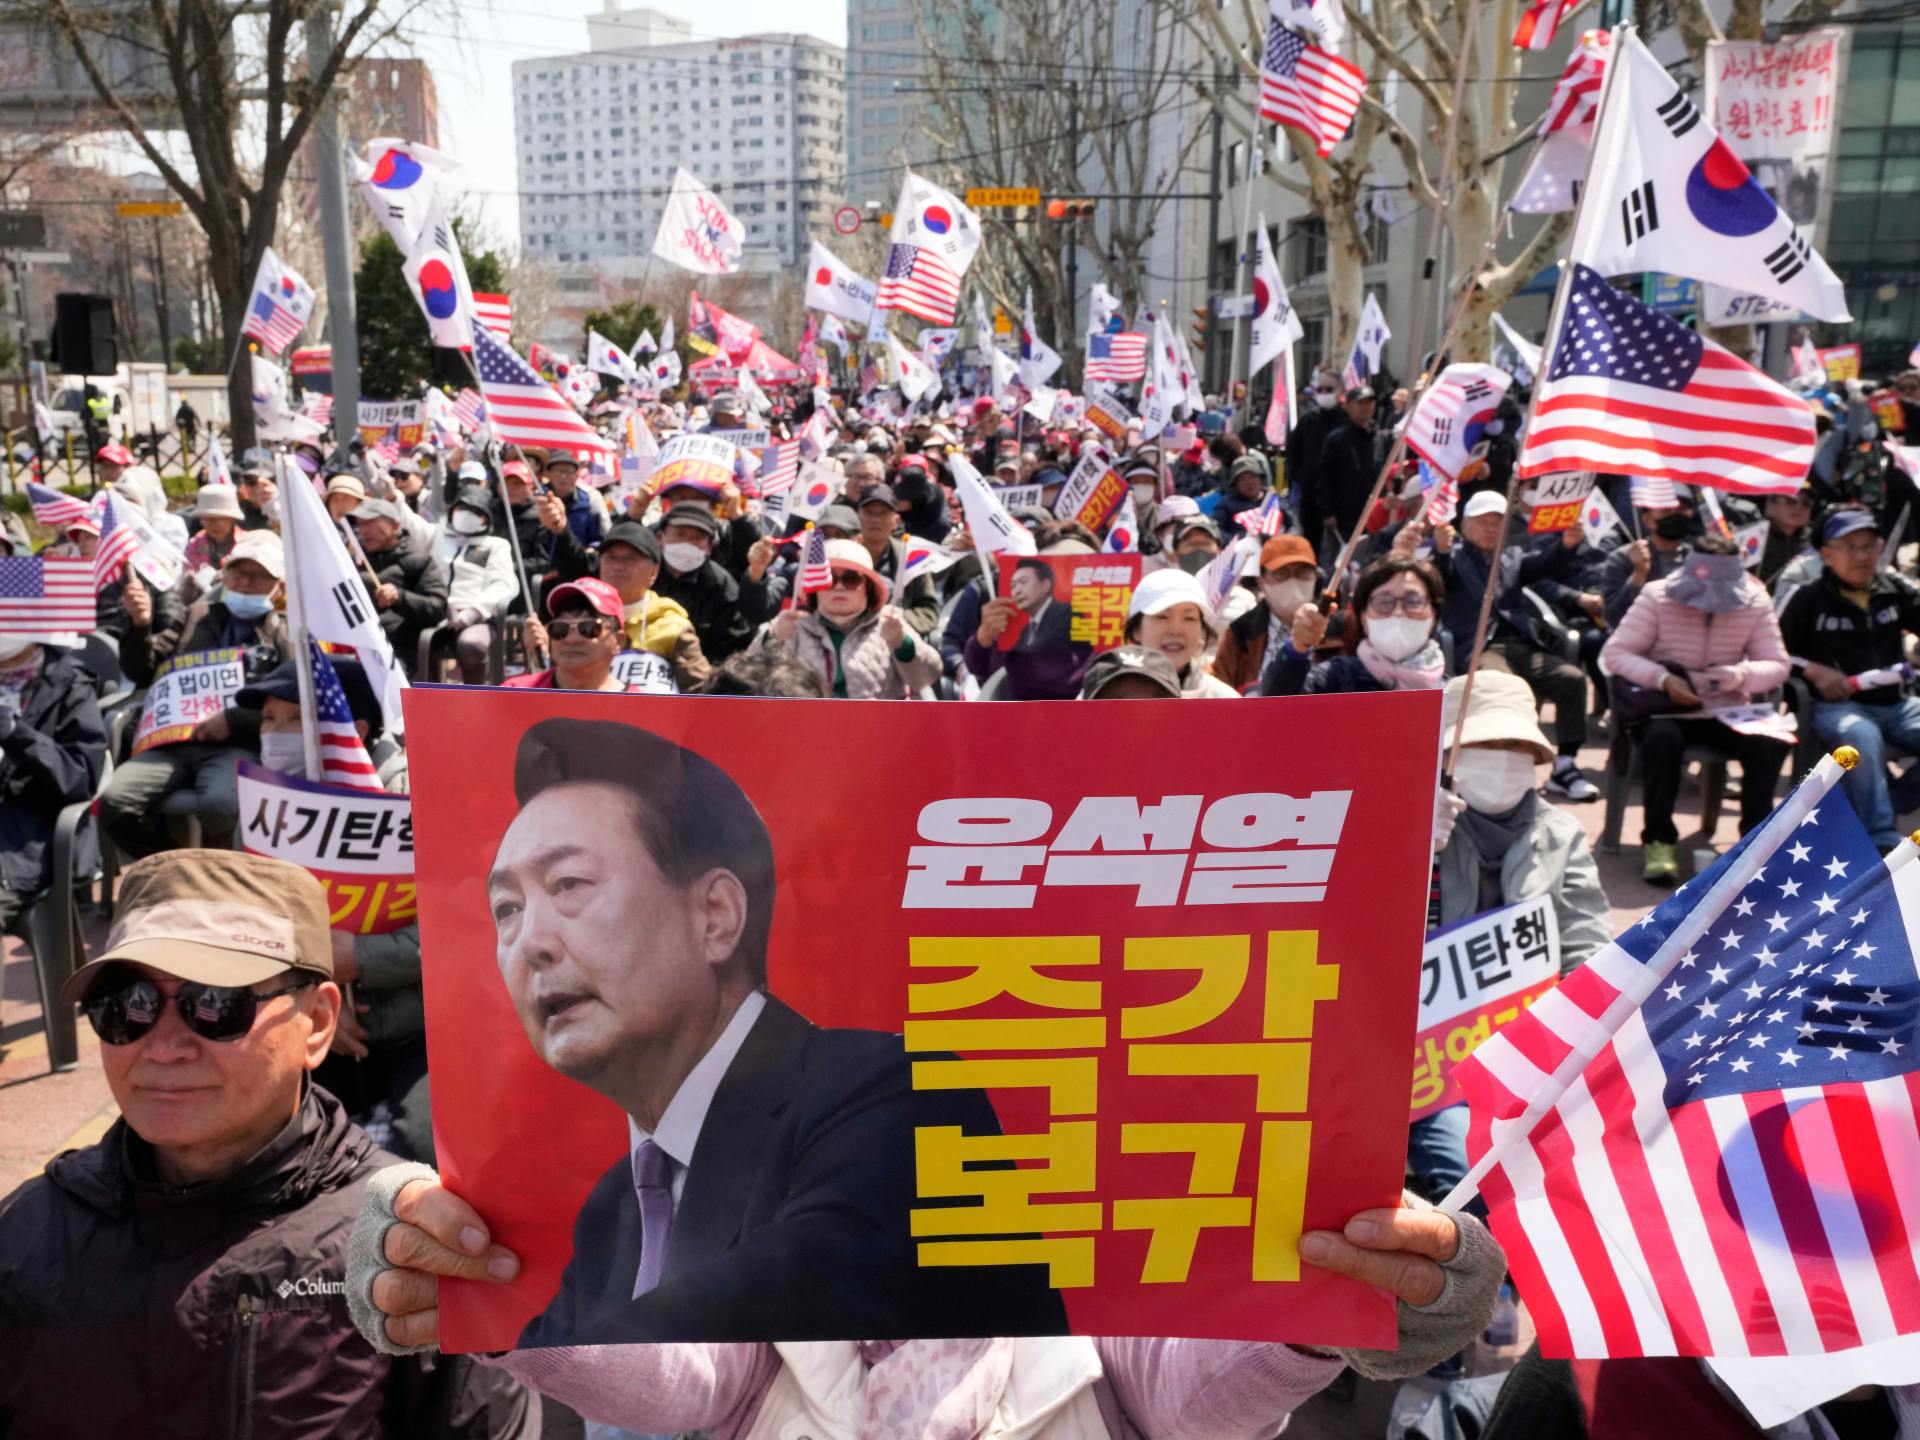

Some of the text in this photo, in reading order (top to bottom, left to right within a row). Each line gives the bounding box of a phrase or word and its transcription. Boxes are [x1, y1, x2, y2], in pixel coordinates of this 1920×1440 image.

[1079, 472, 1122, 534] 연기각
[901, 790, 1353, 909] 윤석열
[1421, 907, 1550, 1008] 기탄핵
[904, 929, 1340, 1116] 즉각
[910, 1120, 1313, 1289] 복귀
[294, 1277, 345, 1296] Colum
